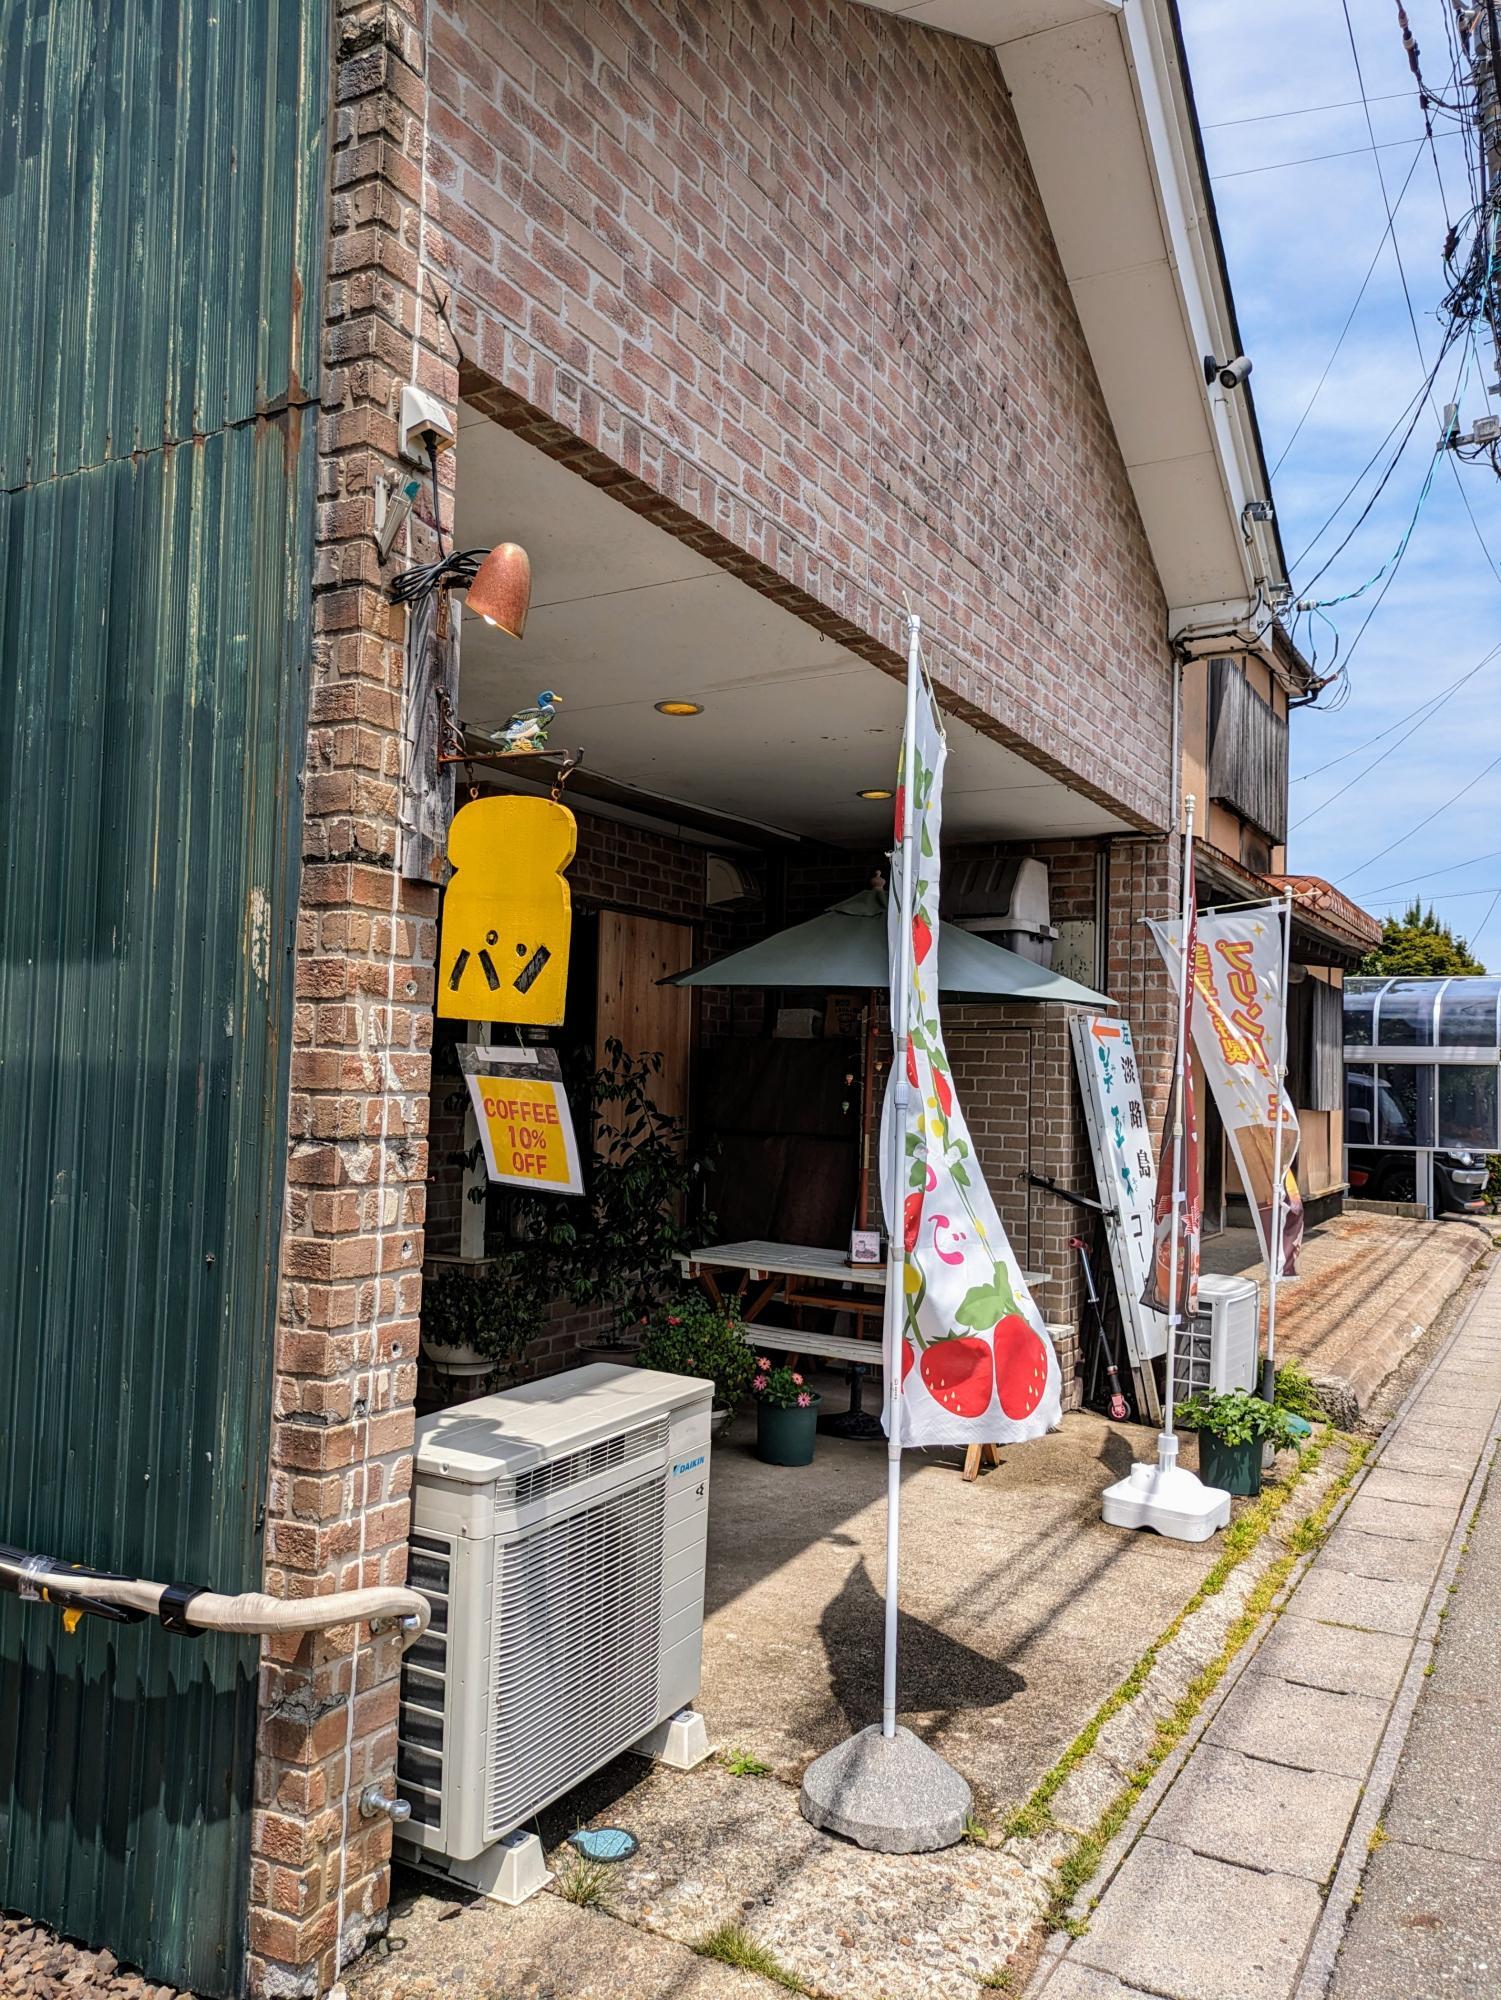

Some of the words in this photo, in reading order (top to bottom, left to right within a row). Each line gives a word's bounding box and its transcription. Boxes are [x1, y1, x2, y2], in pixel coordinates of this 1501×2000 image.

[448, 929, 551, 994] パン
[1121, 1024, 1131, 1045] 左
[483, 1098, 560, 1125] COFFEE
[508, 1125, 547, 1150] 10%
[512, 1151, 548, 1176] OFF
[679, 1455, 705, 1474] DAIKIN
